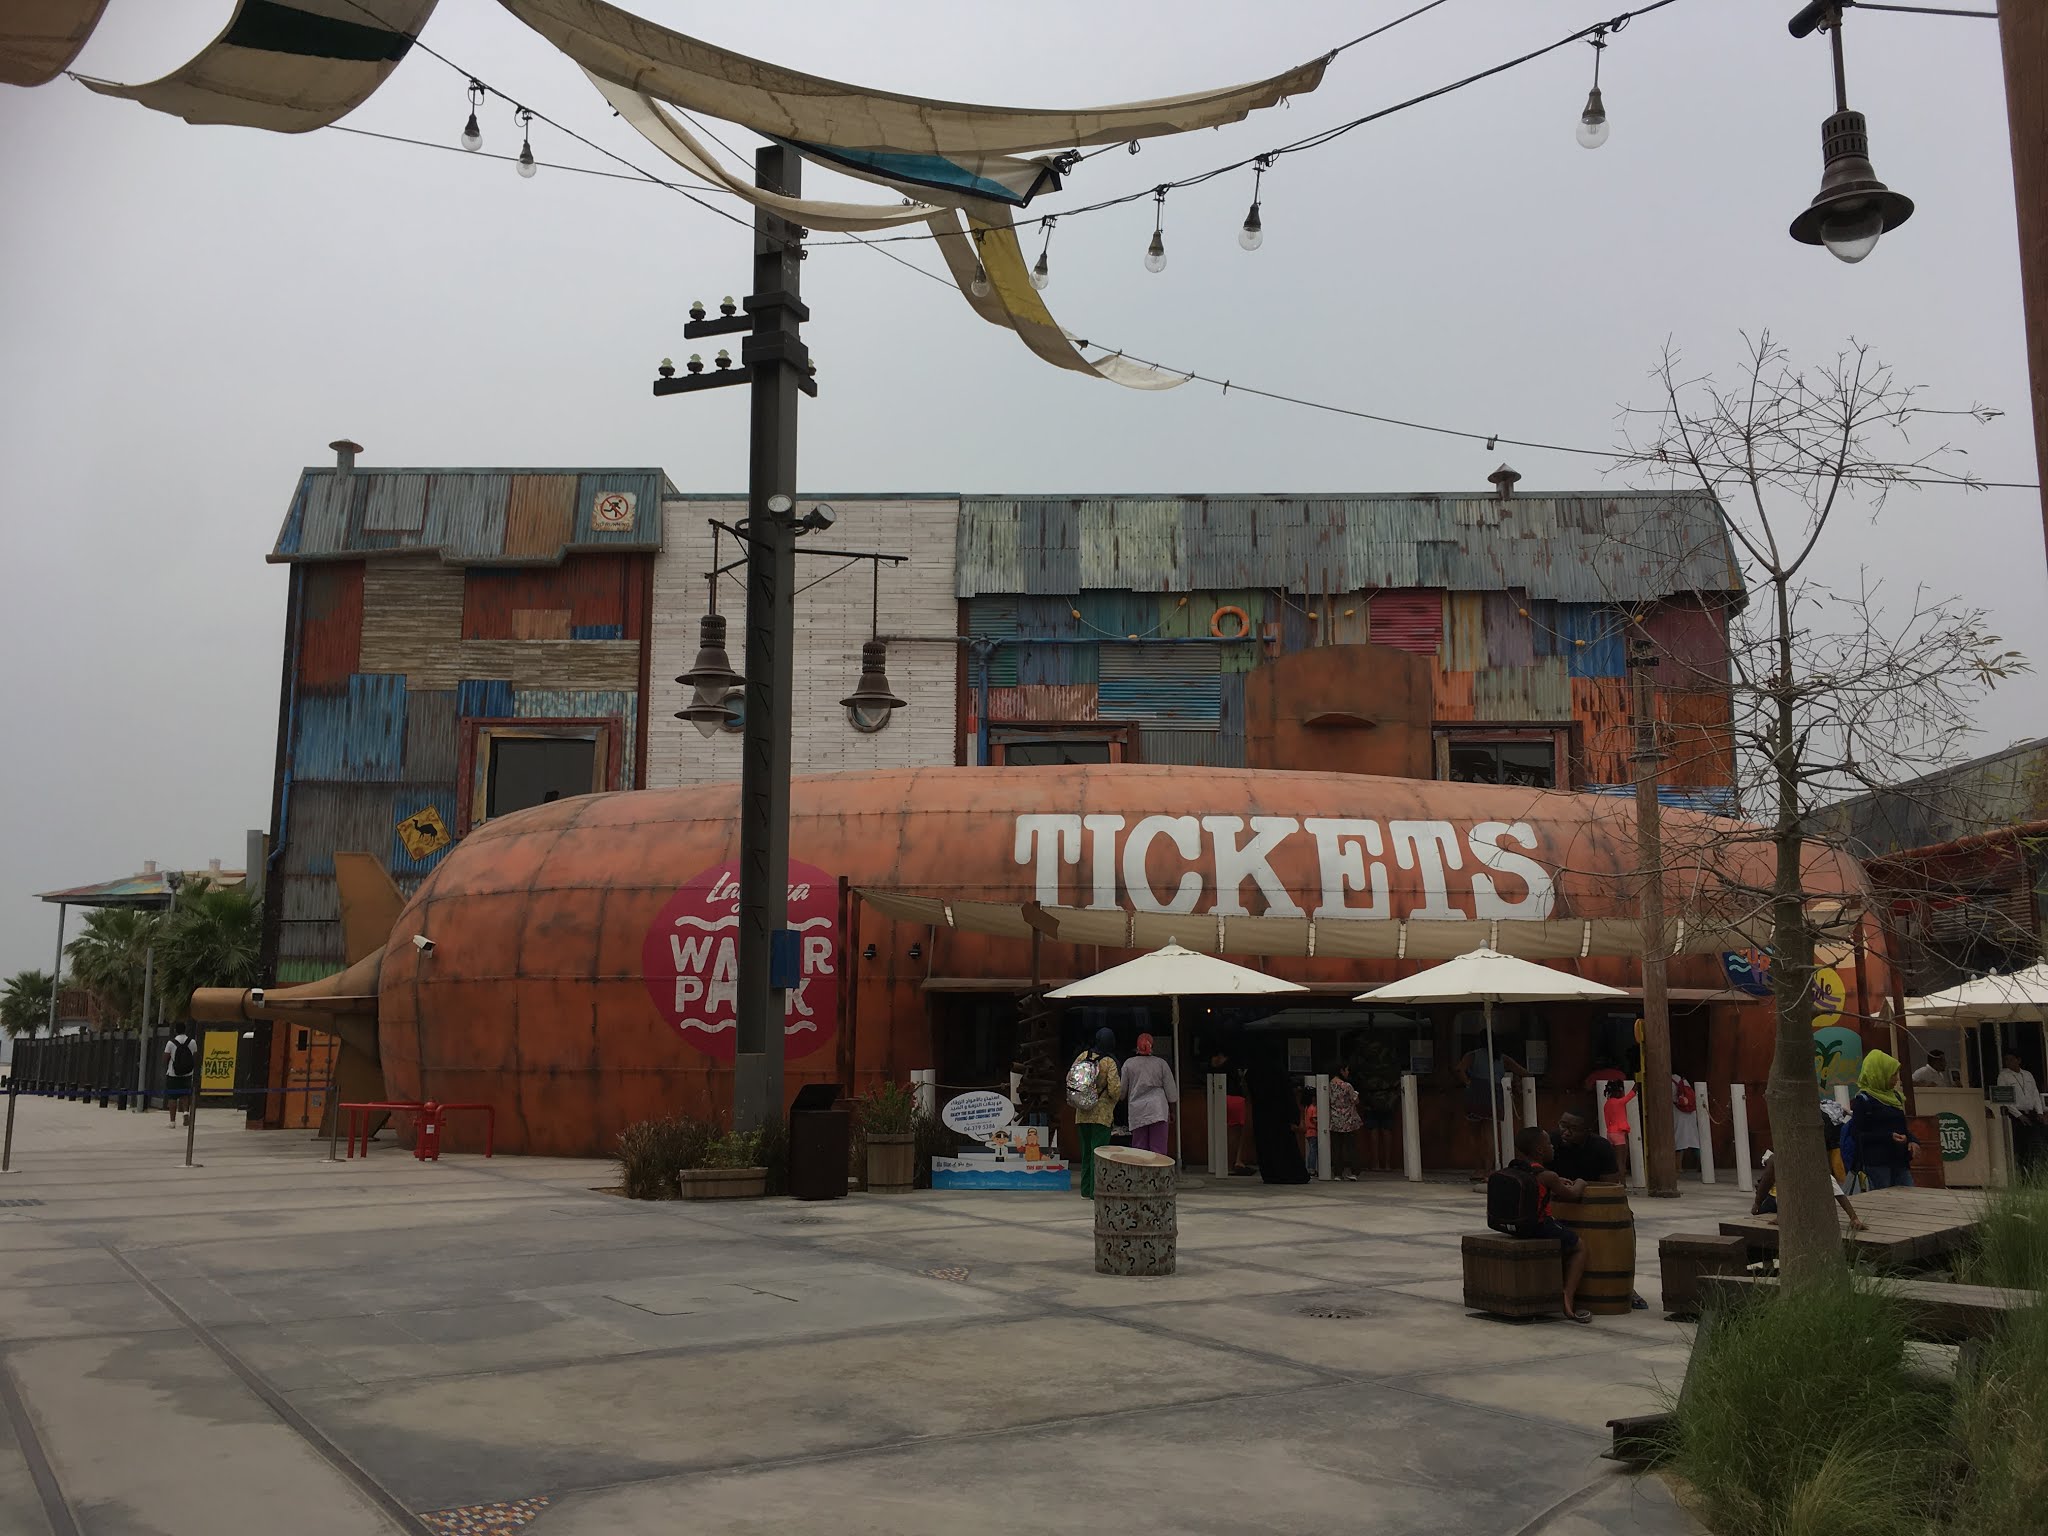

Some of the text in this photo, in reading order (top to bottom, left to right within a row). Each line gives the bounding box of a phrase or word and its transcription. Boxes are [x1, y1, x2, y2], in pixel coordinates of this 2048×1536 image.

[1014, 814, 1556, 922] TICKETS
[670, 934, 835, 976] WAR
[675, 975, 815, 1016] PAK
[205, 1060, 234, 1068] WATER
[205, 1067, 230, 1076] PARK
[1940, 1131, 1967, 1141] ATER
[1940, 1140, 1964, 1150] ARK
